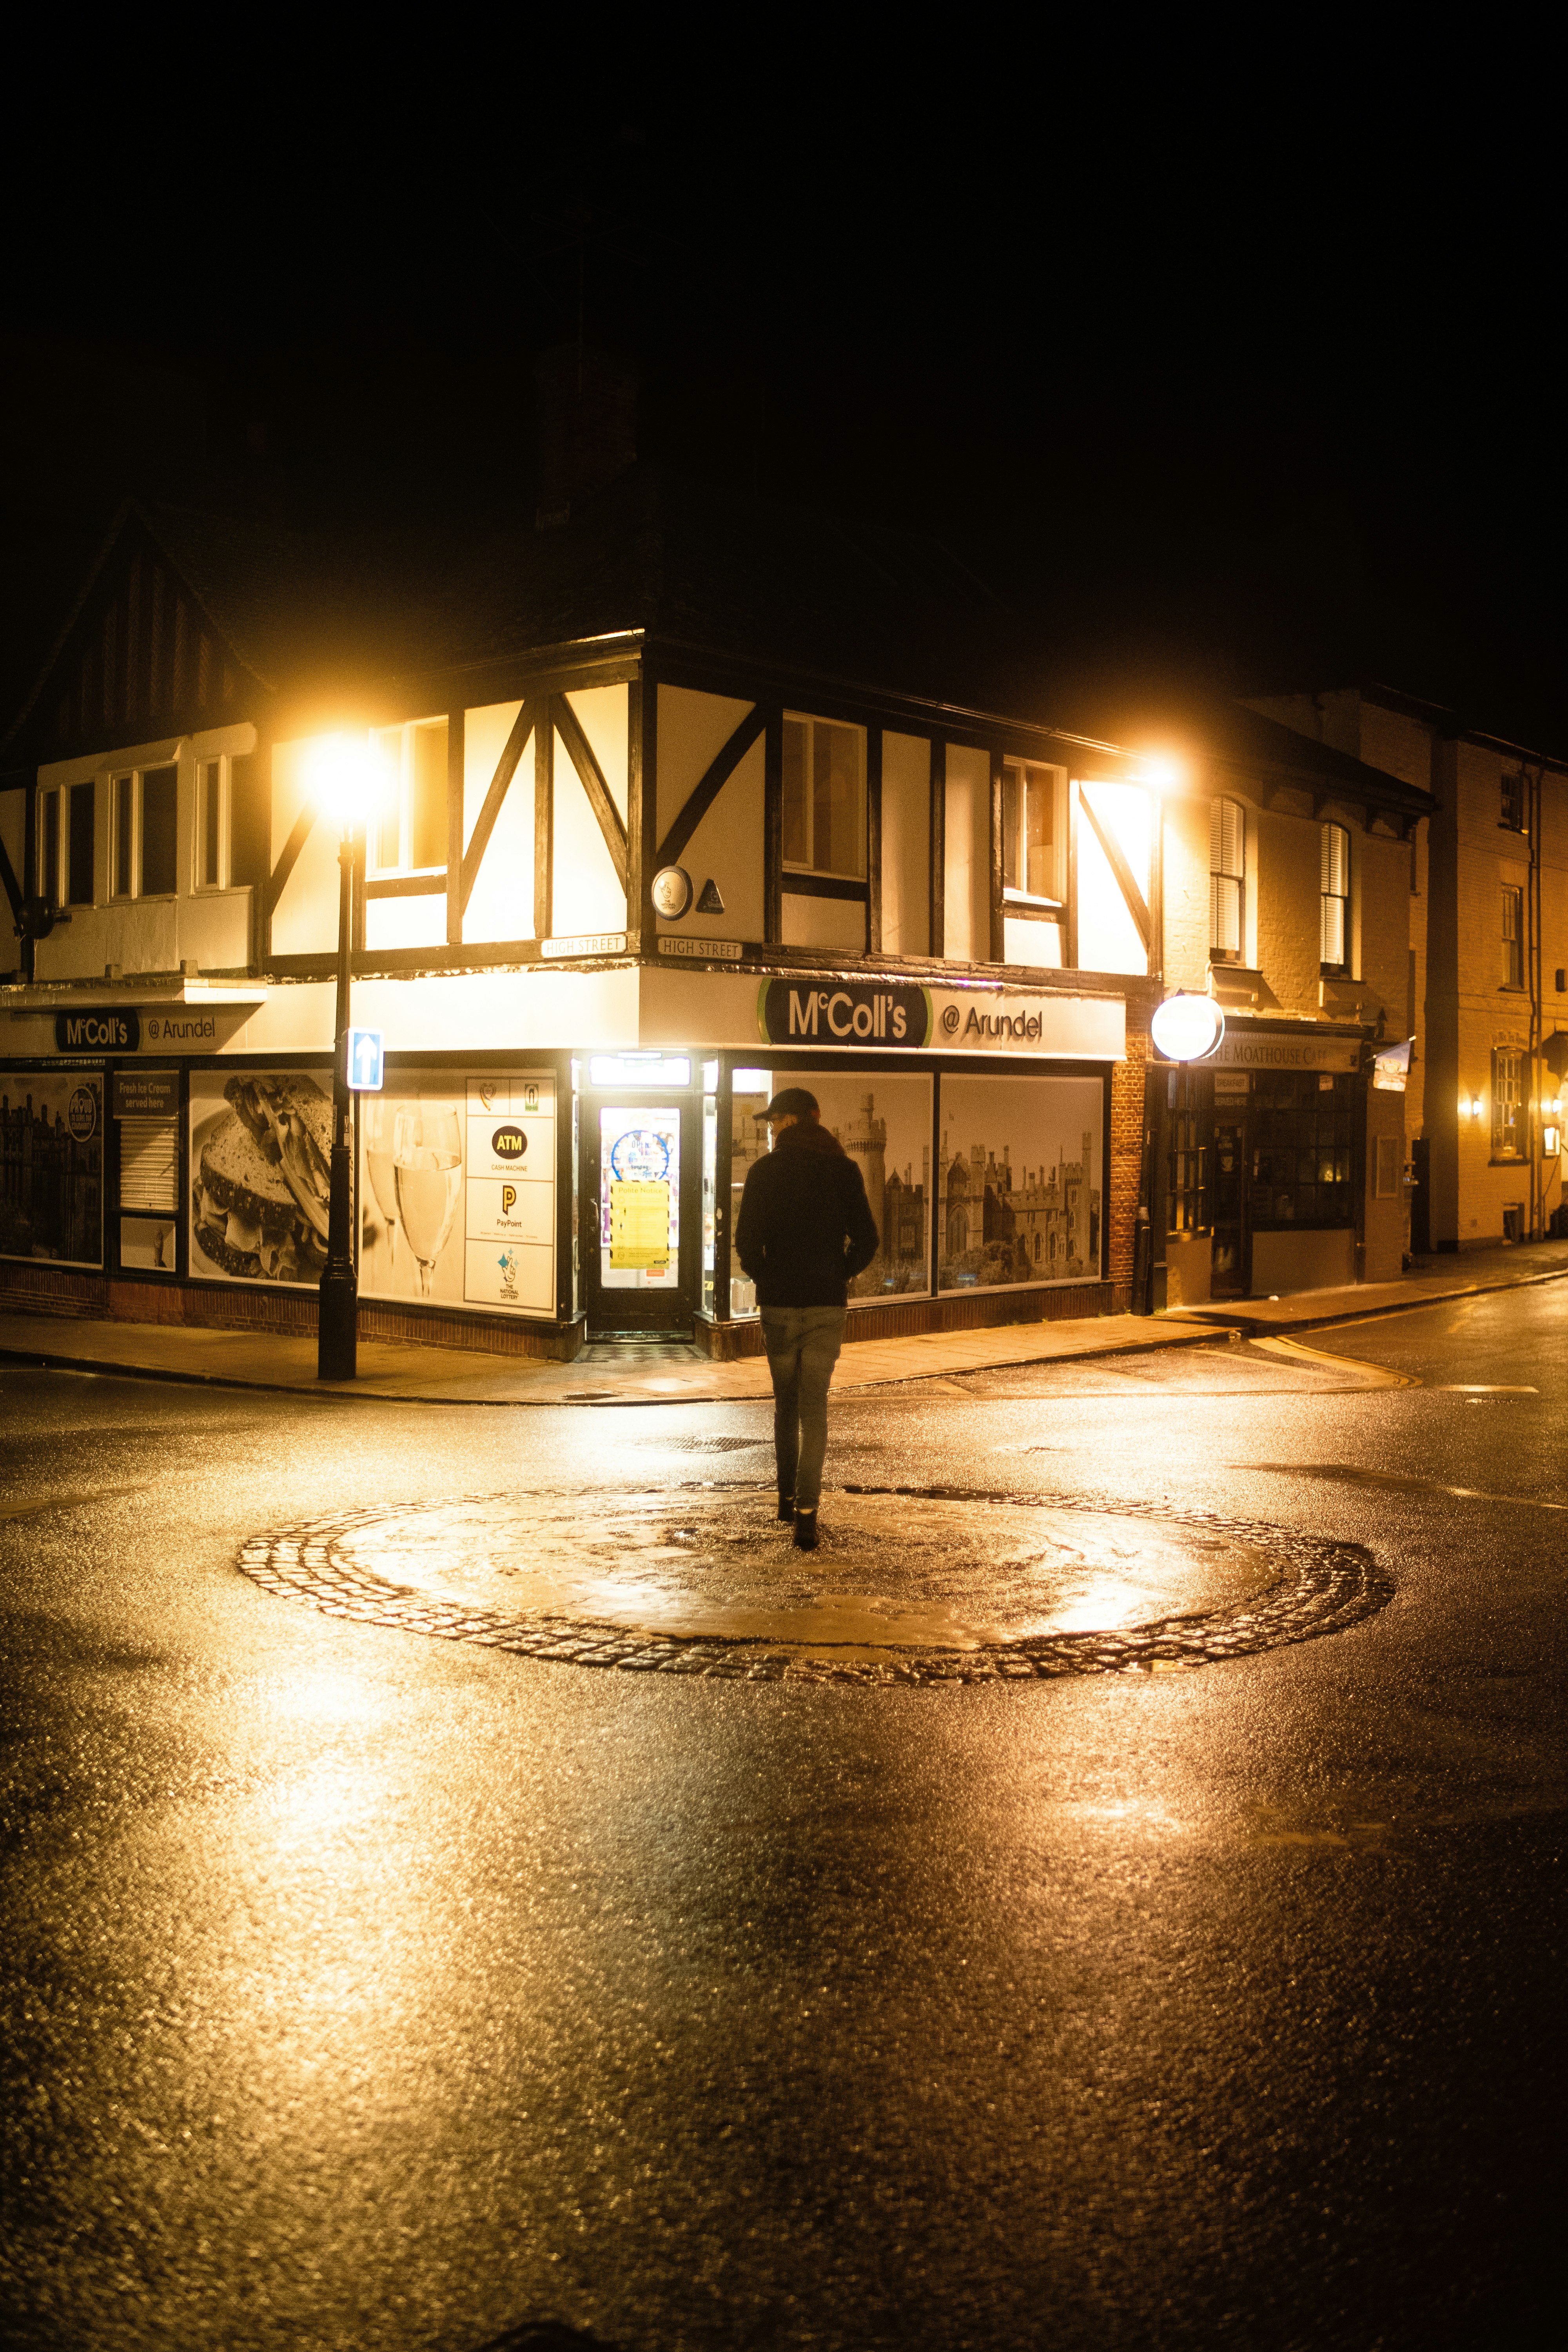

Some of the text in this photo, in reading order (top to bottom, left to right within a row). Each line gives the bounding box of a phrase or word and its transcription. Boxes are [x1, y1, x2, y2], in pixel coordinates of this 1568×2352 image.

[547, 937, 621, 954] HIGH STREET
[664, 939, 739, 957] HIGH STREET
[789, 990, 1042, 1038] McColl's @ Arundel
[67, 1017, 215, 1045] McColl's @ Arundel
[1234, 1044, 1301, 1064] MOATHOUSE
[119, 1082, 171, 1094] Fresh Ice Cream
[70, 1098, 92, 1113] PROUD
[125, 1097, 164, 1108] served here
[496, 1135, 522, 1151] ATM
[497, 1219, 522, 1228] PayPoint
